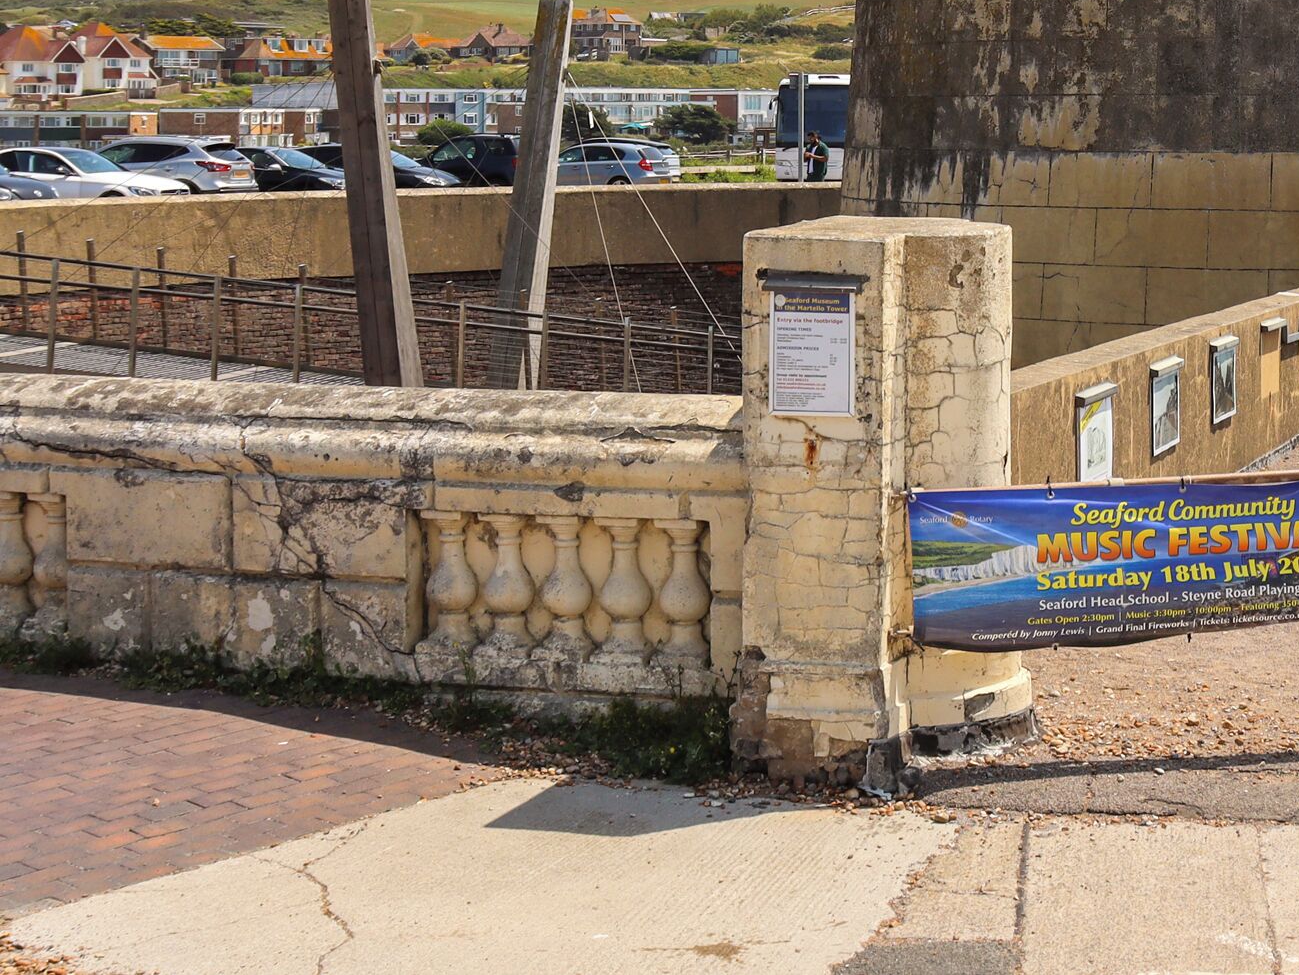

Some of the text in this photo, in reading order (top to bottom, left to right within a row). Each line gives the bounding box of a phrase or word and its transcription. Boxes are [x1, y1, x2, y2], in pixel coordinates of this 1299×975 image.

[814, 317, 843, 325] footbridge
[919, 515, 993, 524] Seaford Rotary
[1071, 496, 1296, 529] Seaford Community
[1036, 528, 1156, 563] MUSIC
[1037, 564, 1152, 591] Saturday
[1161, 561, 1216, 584] 18th
[1223, 557, 1271, 583] July
[1039, 596, 1087, 611] Seaford
[1090, 594, 1124, 607] Head
[1128, 591, 1169, 605] School
[1181, 590, 1221, 603] Steyne
[1225, 585, 1256, 599] Road
[1027, 617, 1052, 625] Gates
[1055, 615, 1079, 625] Open
[1082, 613, 1115, 623] 2:30pm
[1125, 610, 1151, 619] Music
[1154, 608, 1186, 618] 3:30pm
[1195, 605, 1232, 616] 10:00pm
[1241, 602, 1280, 612] Featuring
[1020, 630, 1031, 639] by
[1032, 629, 1058, 638] Jonny
[1061, 626, 1085, 635] Lewis
[1096, 624, 1123, 634] Grand
[1125, 621, 1146, 632] Final
[1148, 620, 1189, 630] Fireworks
[1200, 616, 1230, 626] Tickets:
